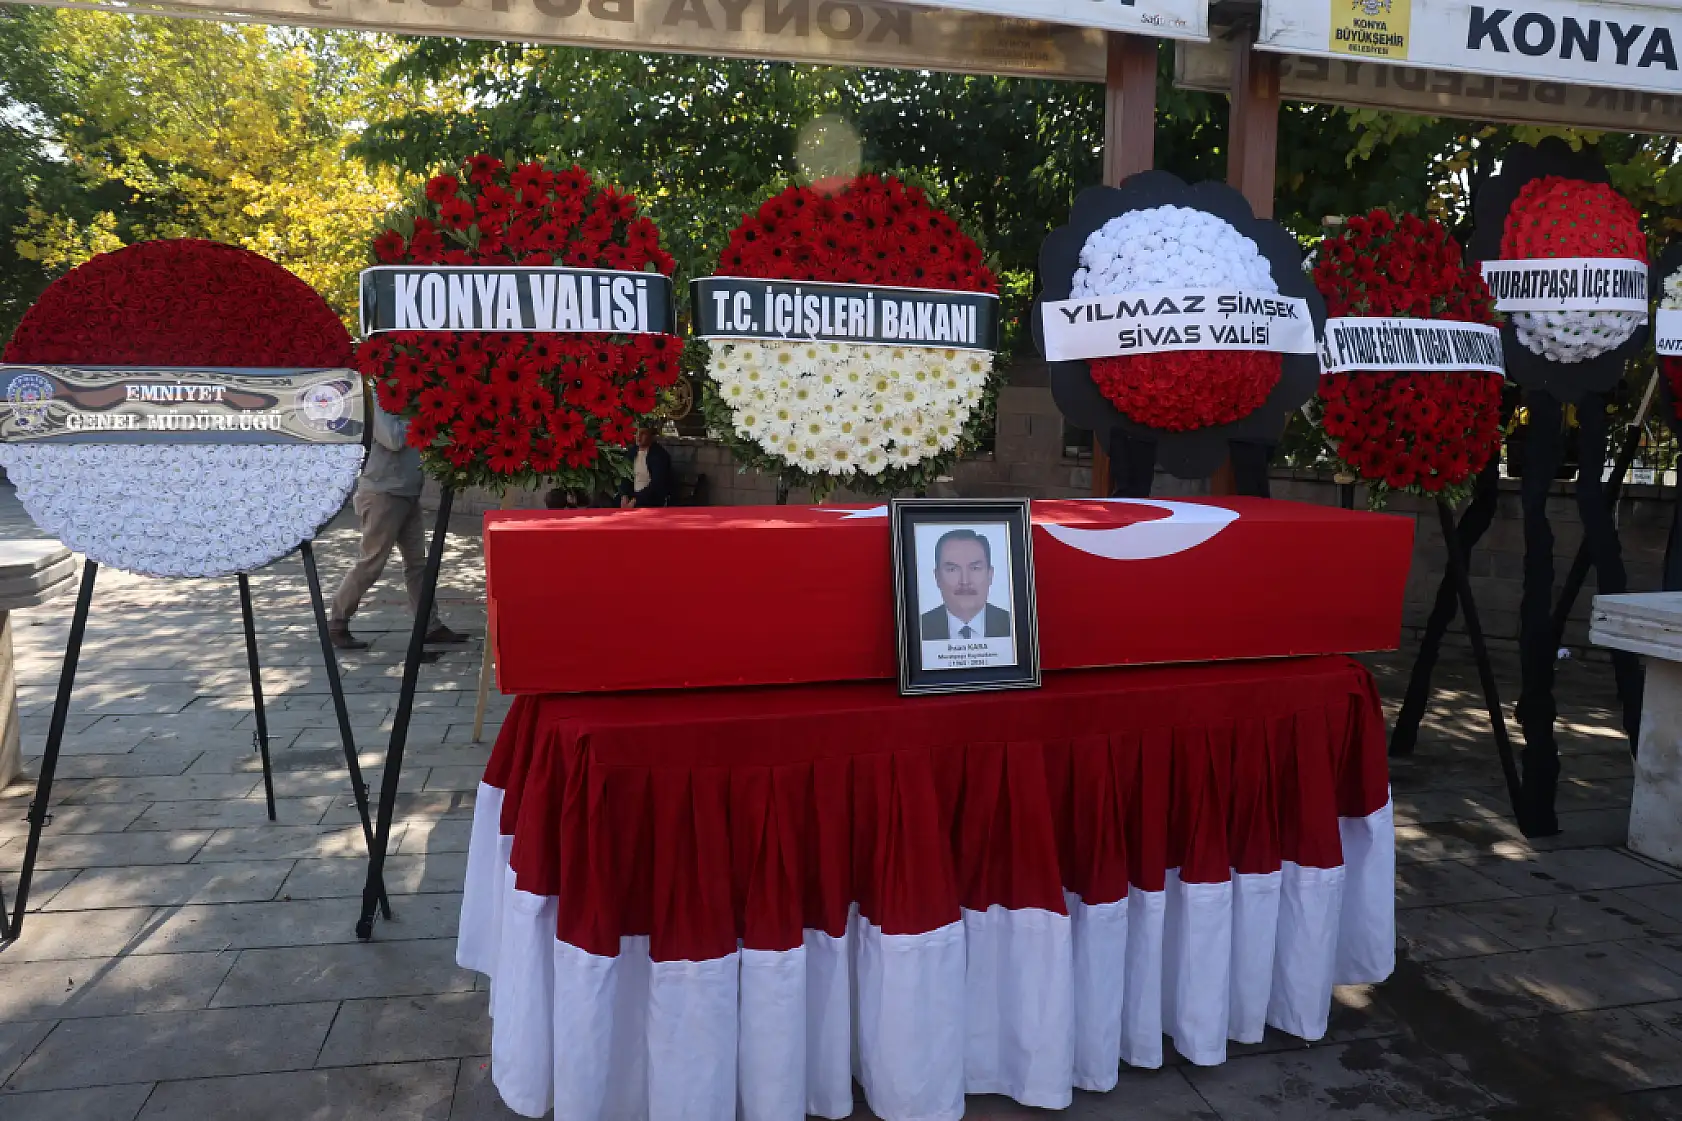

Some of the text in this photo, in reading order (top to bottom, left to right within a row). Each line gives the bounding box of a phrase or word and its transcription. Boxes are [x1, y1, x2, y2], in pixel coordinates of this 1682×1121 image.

[1336, 26, 1404, 48] BÜYÜKŞEHİR
[1353, 18, 1387, 31] KONYA
[1466, 5, 1679, 71] KONYA
[394, 272, 649, 331] KONYA VALİSİ
[1487, 268, 1578, 305] MURATPAŞA
[1581, 263, 1609, 305] İLÇE
[711, 285, 977, 345] T.C. İÇİŞLERİ BAKANI
[1059, 290, 1299, 325] YILMAZ ŞİMŞEK
[1118, 321, 1270, 349] SİVAS VALİSİ
[1333, 321, 1380, 365] PİYADE
[1376, 320, 1420, 365] EĞİTİM
[125, 380, 226, 402] EMNİYET
[66, 409, 282, 431] GENEL MÜDÜRLÜĞÜ
